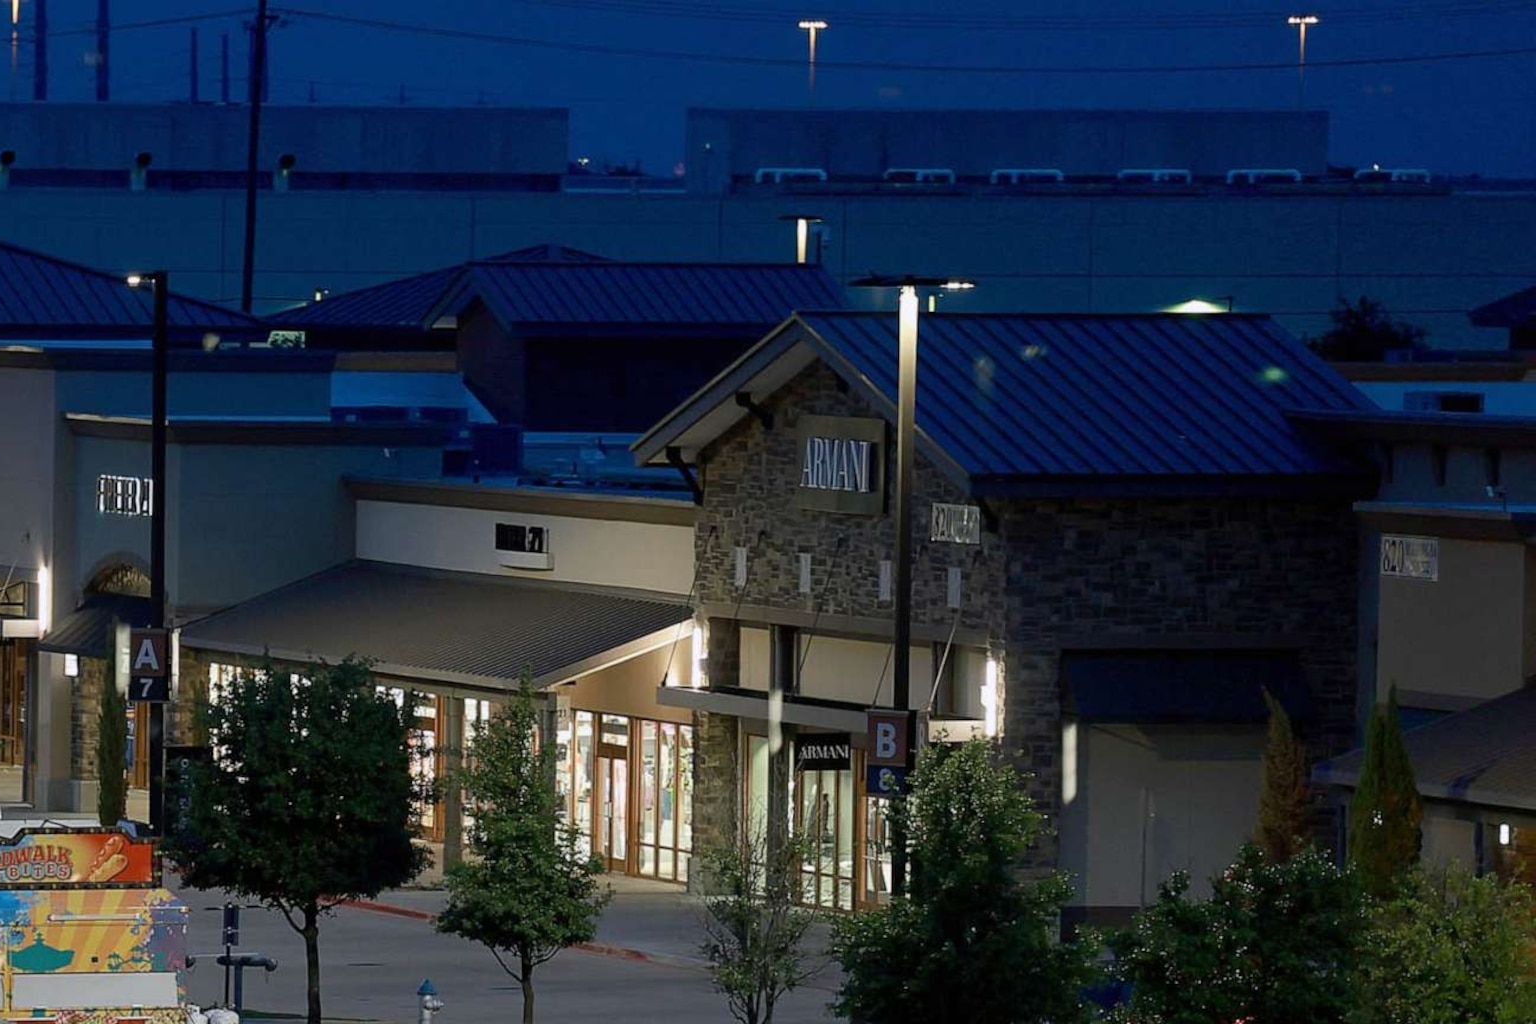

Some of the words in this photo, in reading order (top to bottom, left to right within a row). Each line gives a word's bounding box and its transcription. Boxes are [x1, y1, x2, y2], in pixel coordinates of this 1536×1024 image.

[799, 436, 872, 493] ARMANI
[133, 638, 160, 671] A
[139, 677, 153, 698] 7
[798, 744, 850, 760] ARMANI
[876, 722, 896, 759] B
[7, 862, 72, 880] BITES
